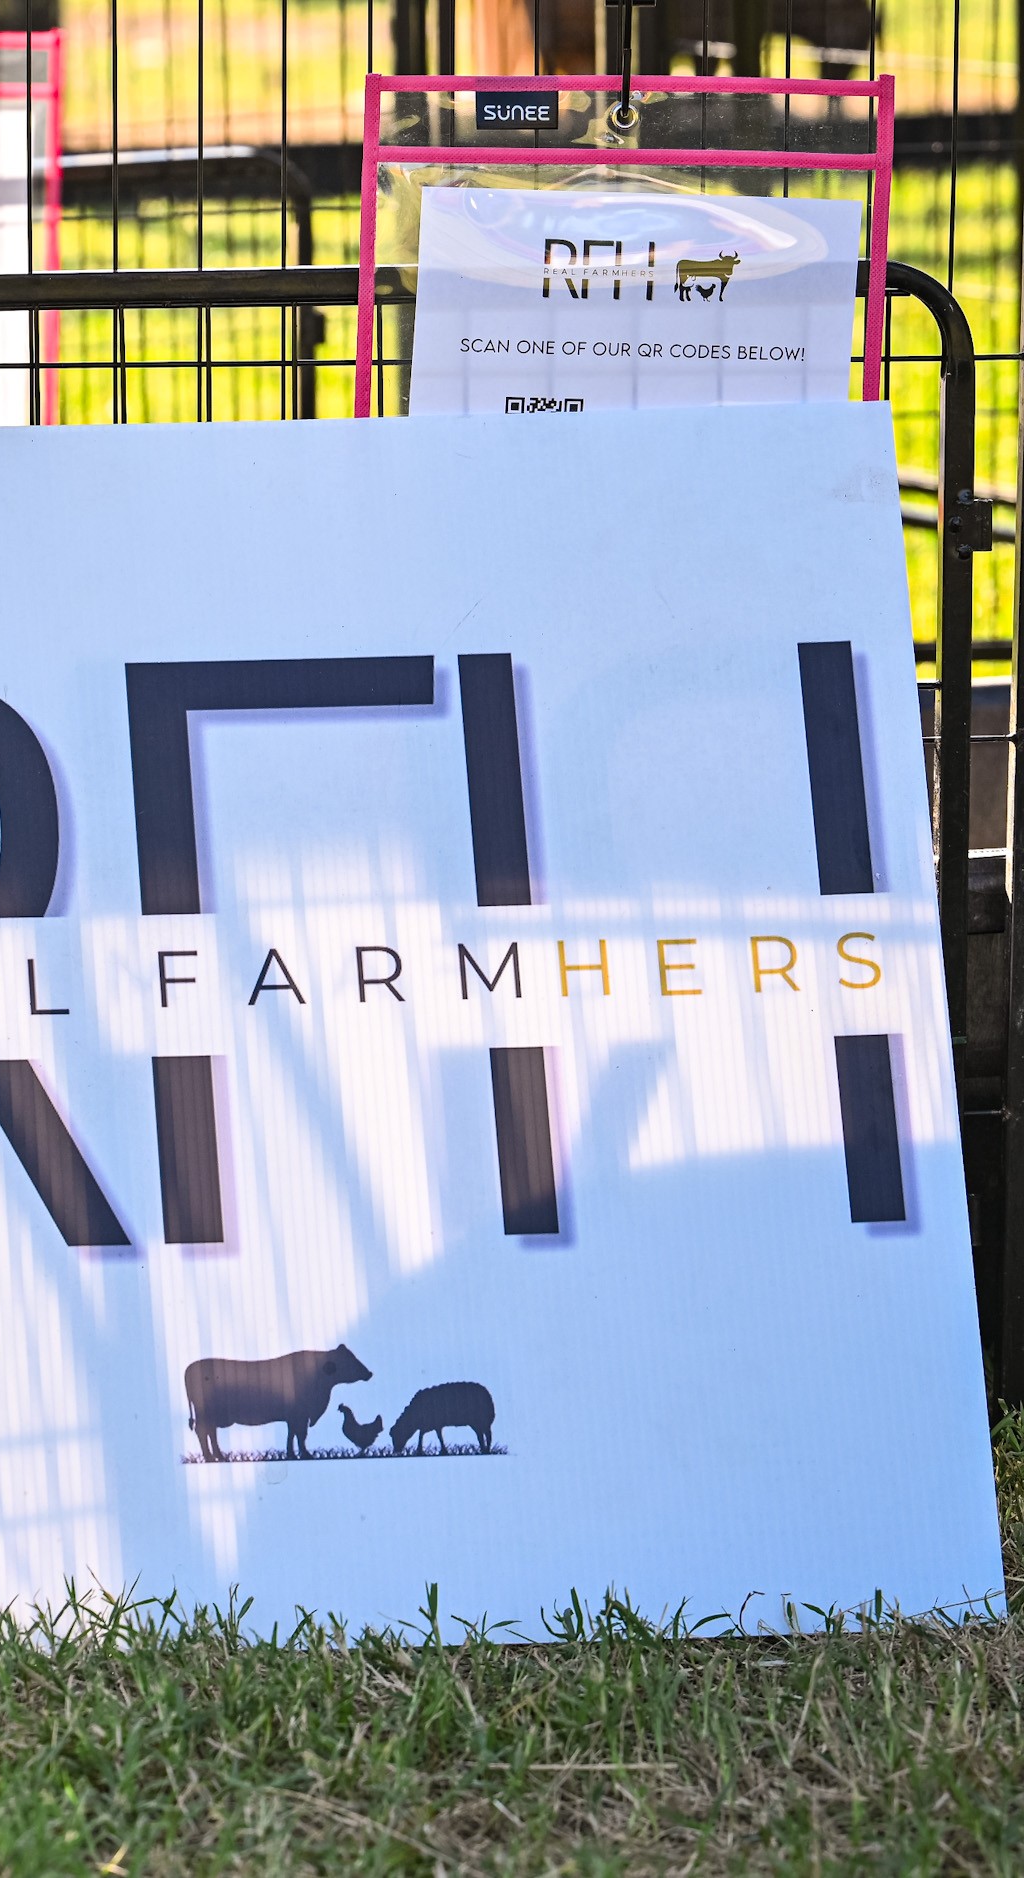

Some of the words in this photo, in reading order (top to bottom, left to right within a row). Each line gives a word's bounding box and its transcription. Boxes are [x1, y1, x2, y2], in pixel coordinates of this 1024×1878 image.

[543, 268, 576, 276] REAL
[583, 268, 655, 277] FARMHERS
[460, 338, 510, 353] SCAN
[516, 340, 555, 355] ONE
[561, 341, 587, 356] OF
[593, 342, 631, 357] OUR
[637, 344, 662, 358] QR
[669, 344, 731, 360] CODES
[738, 346, 806, 362] BELOW!
[158, 932, 883, 1007] FARMHERS
